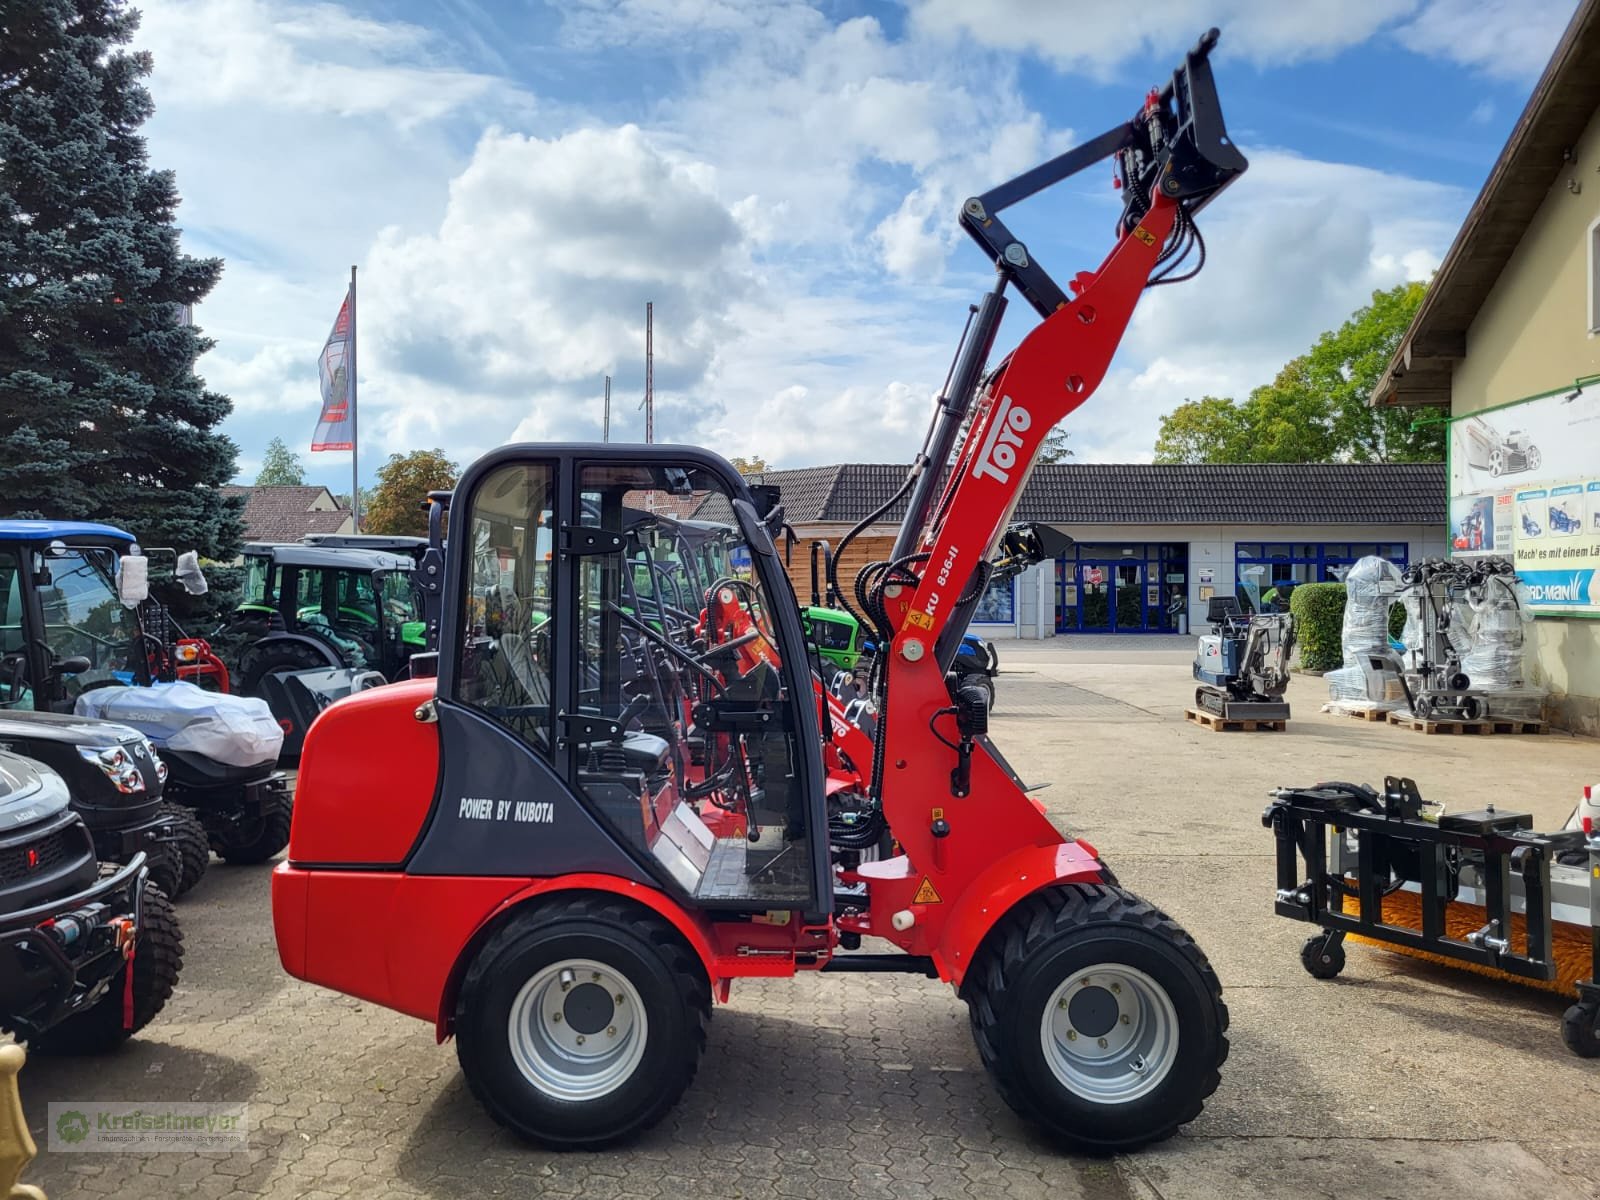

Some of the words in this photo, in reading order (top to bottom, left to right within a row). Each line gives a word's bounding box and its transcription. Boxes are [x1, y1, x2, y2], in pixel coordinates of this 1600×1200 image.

[1538, 549, 1547, 559] es
[1548, 546, 1561, 558] mit
[1562, 546, 1588, 558] einem
[926, 592, 938, 616] KU
[458, 798, 493, 819] POWER
[496, 799, 511, 821] BY
[514, 802, 554, 823] KUBOTA
